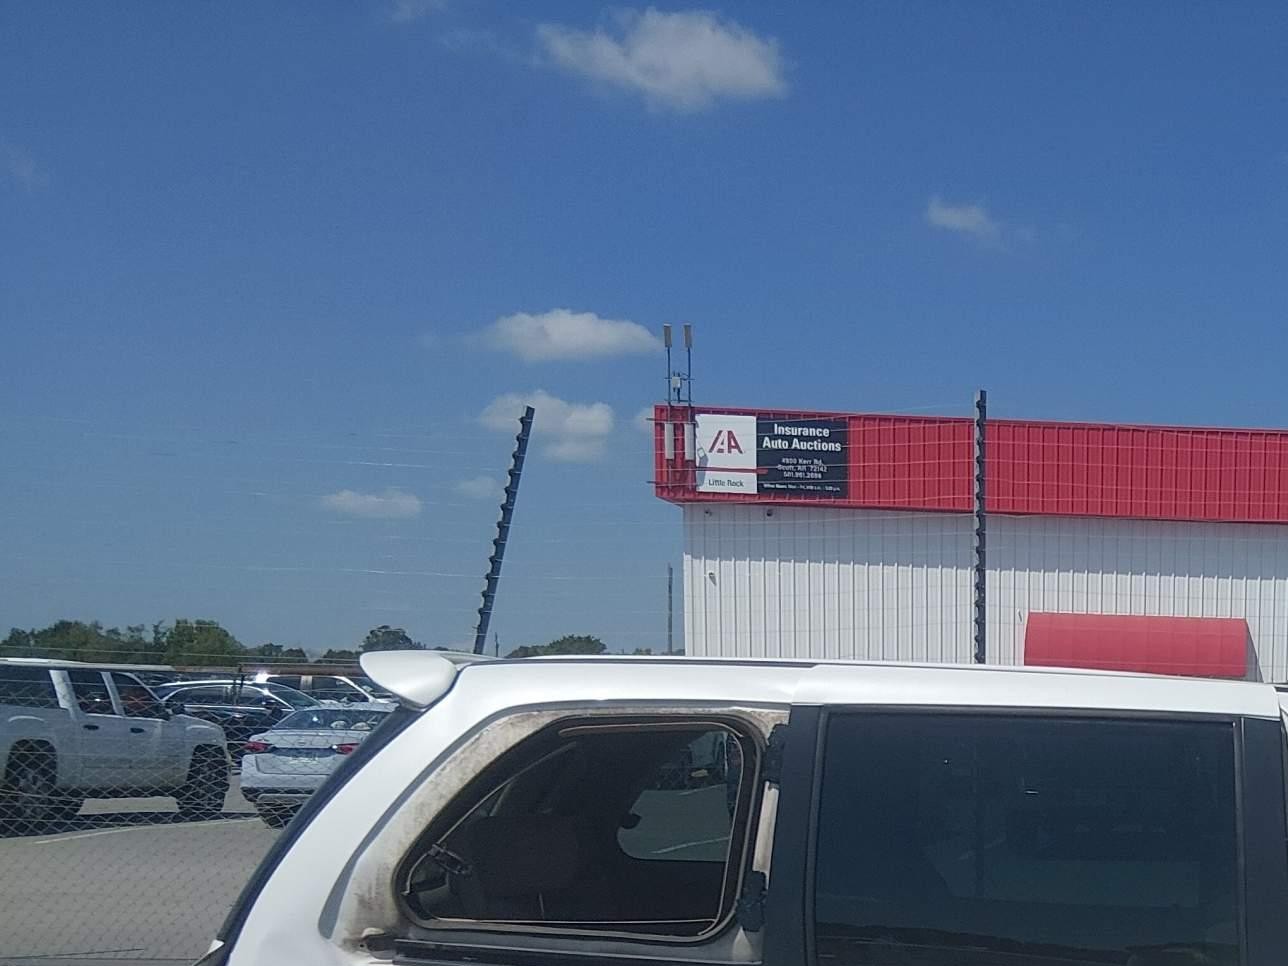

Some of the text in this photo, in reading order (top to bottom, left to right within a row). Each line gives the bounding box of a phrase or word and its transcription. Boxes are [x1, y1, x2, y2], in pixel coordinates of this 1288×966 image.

[774, 423, 830, 437] Insurance
[762, 437, 841, 452] Auto Auctions
[708, 479, 744, 488] Little Rock
